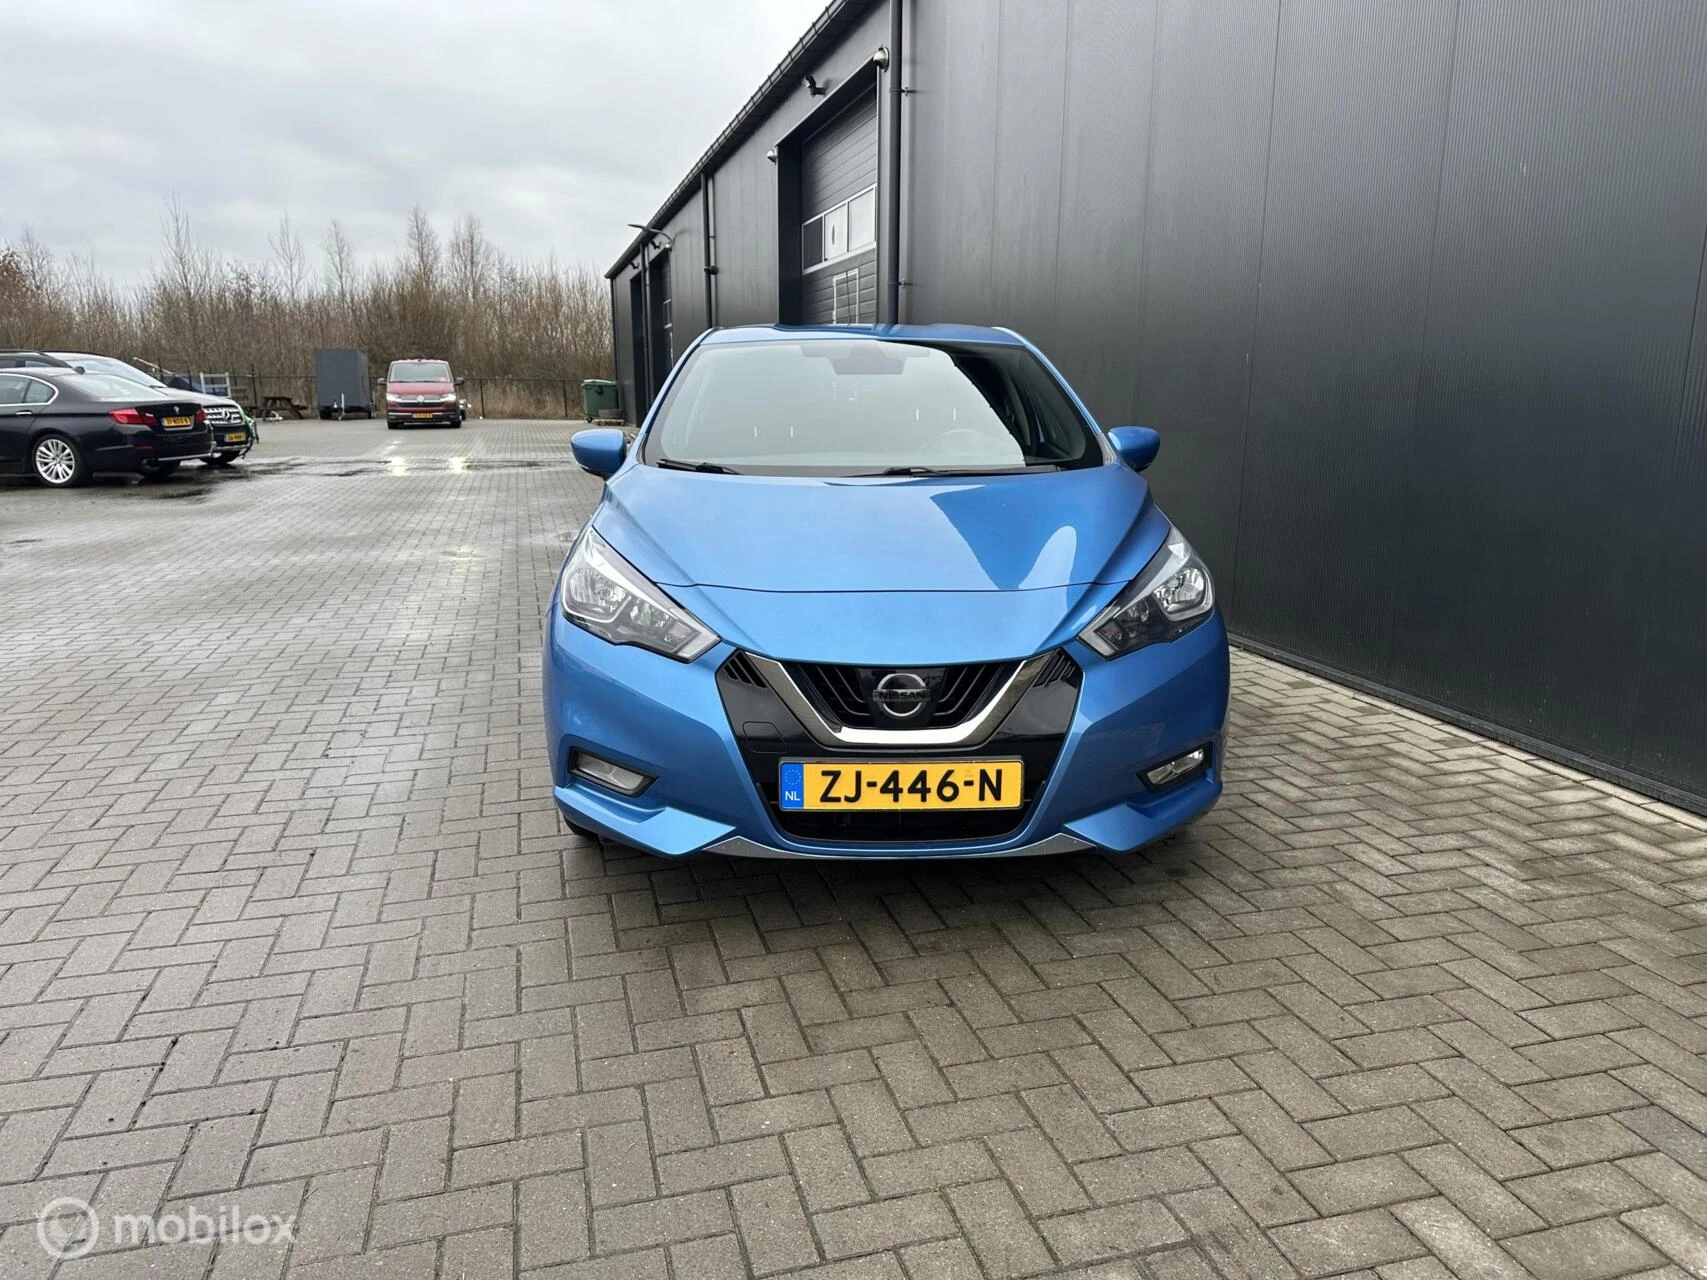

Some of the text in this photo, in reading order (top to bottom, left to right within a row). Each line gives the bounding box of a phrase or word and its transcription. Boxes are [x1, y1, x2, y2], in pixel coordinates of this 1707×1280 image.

[878, 690, 926, 699] NISSAN
[819, 768, 1003, 803] ZJ-446-N
[785, 790, 801, 801] NL
